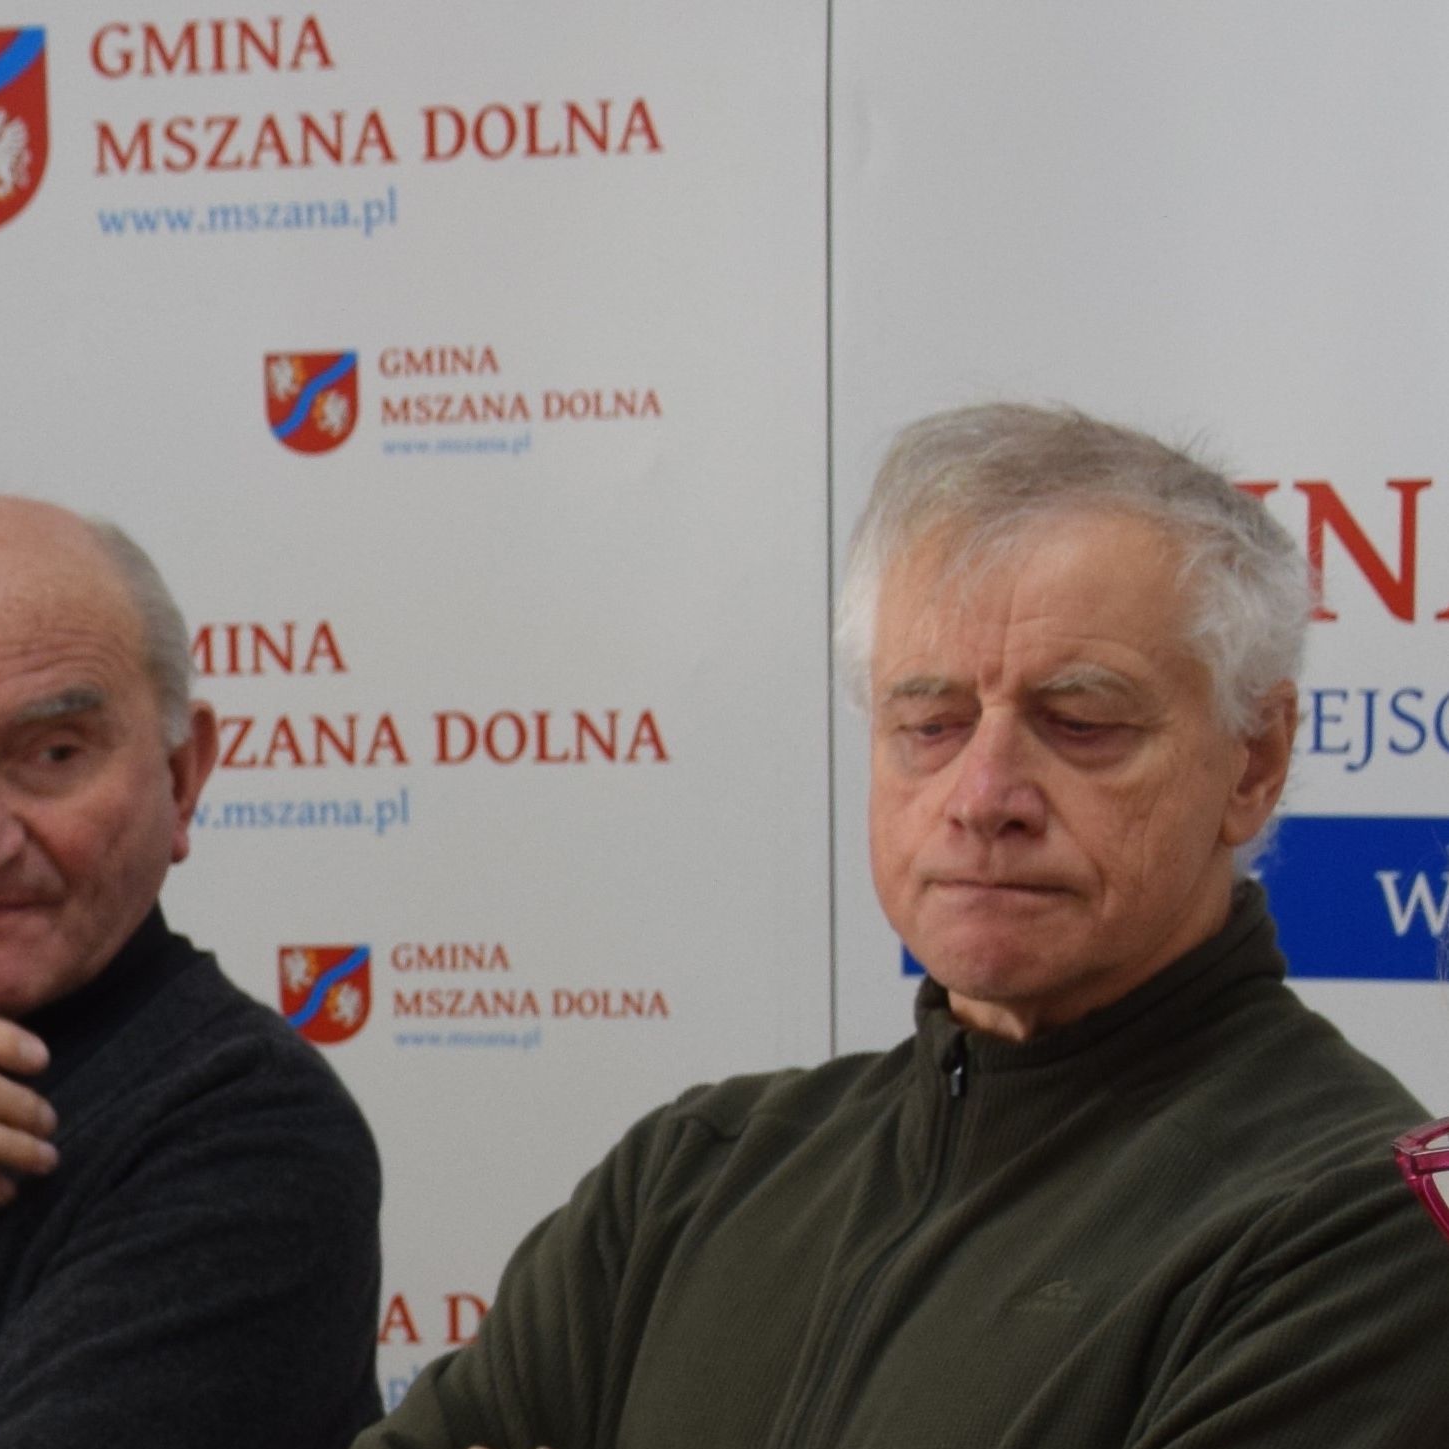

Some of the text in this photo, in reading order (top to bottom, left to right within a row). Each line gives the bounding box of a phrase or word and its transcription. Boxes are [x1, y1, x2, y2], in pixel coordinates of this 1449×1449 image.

[89, 14, 336, 79] GMINA
[94, 97, 664, 175] MSZANA DOLNA
[96, 184, 399, 238] www.mszana.pl
[378, 345, 500, 376] GMINA
[380, 389, 663, 425] MSZANA DOLNA
[217, 709, 670, 769] ZANA DOLNA
[1307, 686, 1449, 773] EJS
[390, 942, 511, 972] GMINA
[393, 988, 670, 1019] MSZANA DOLNA
